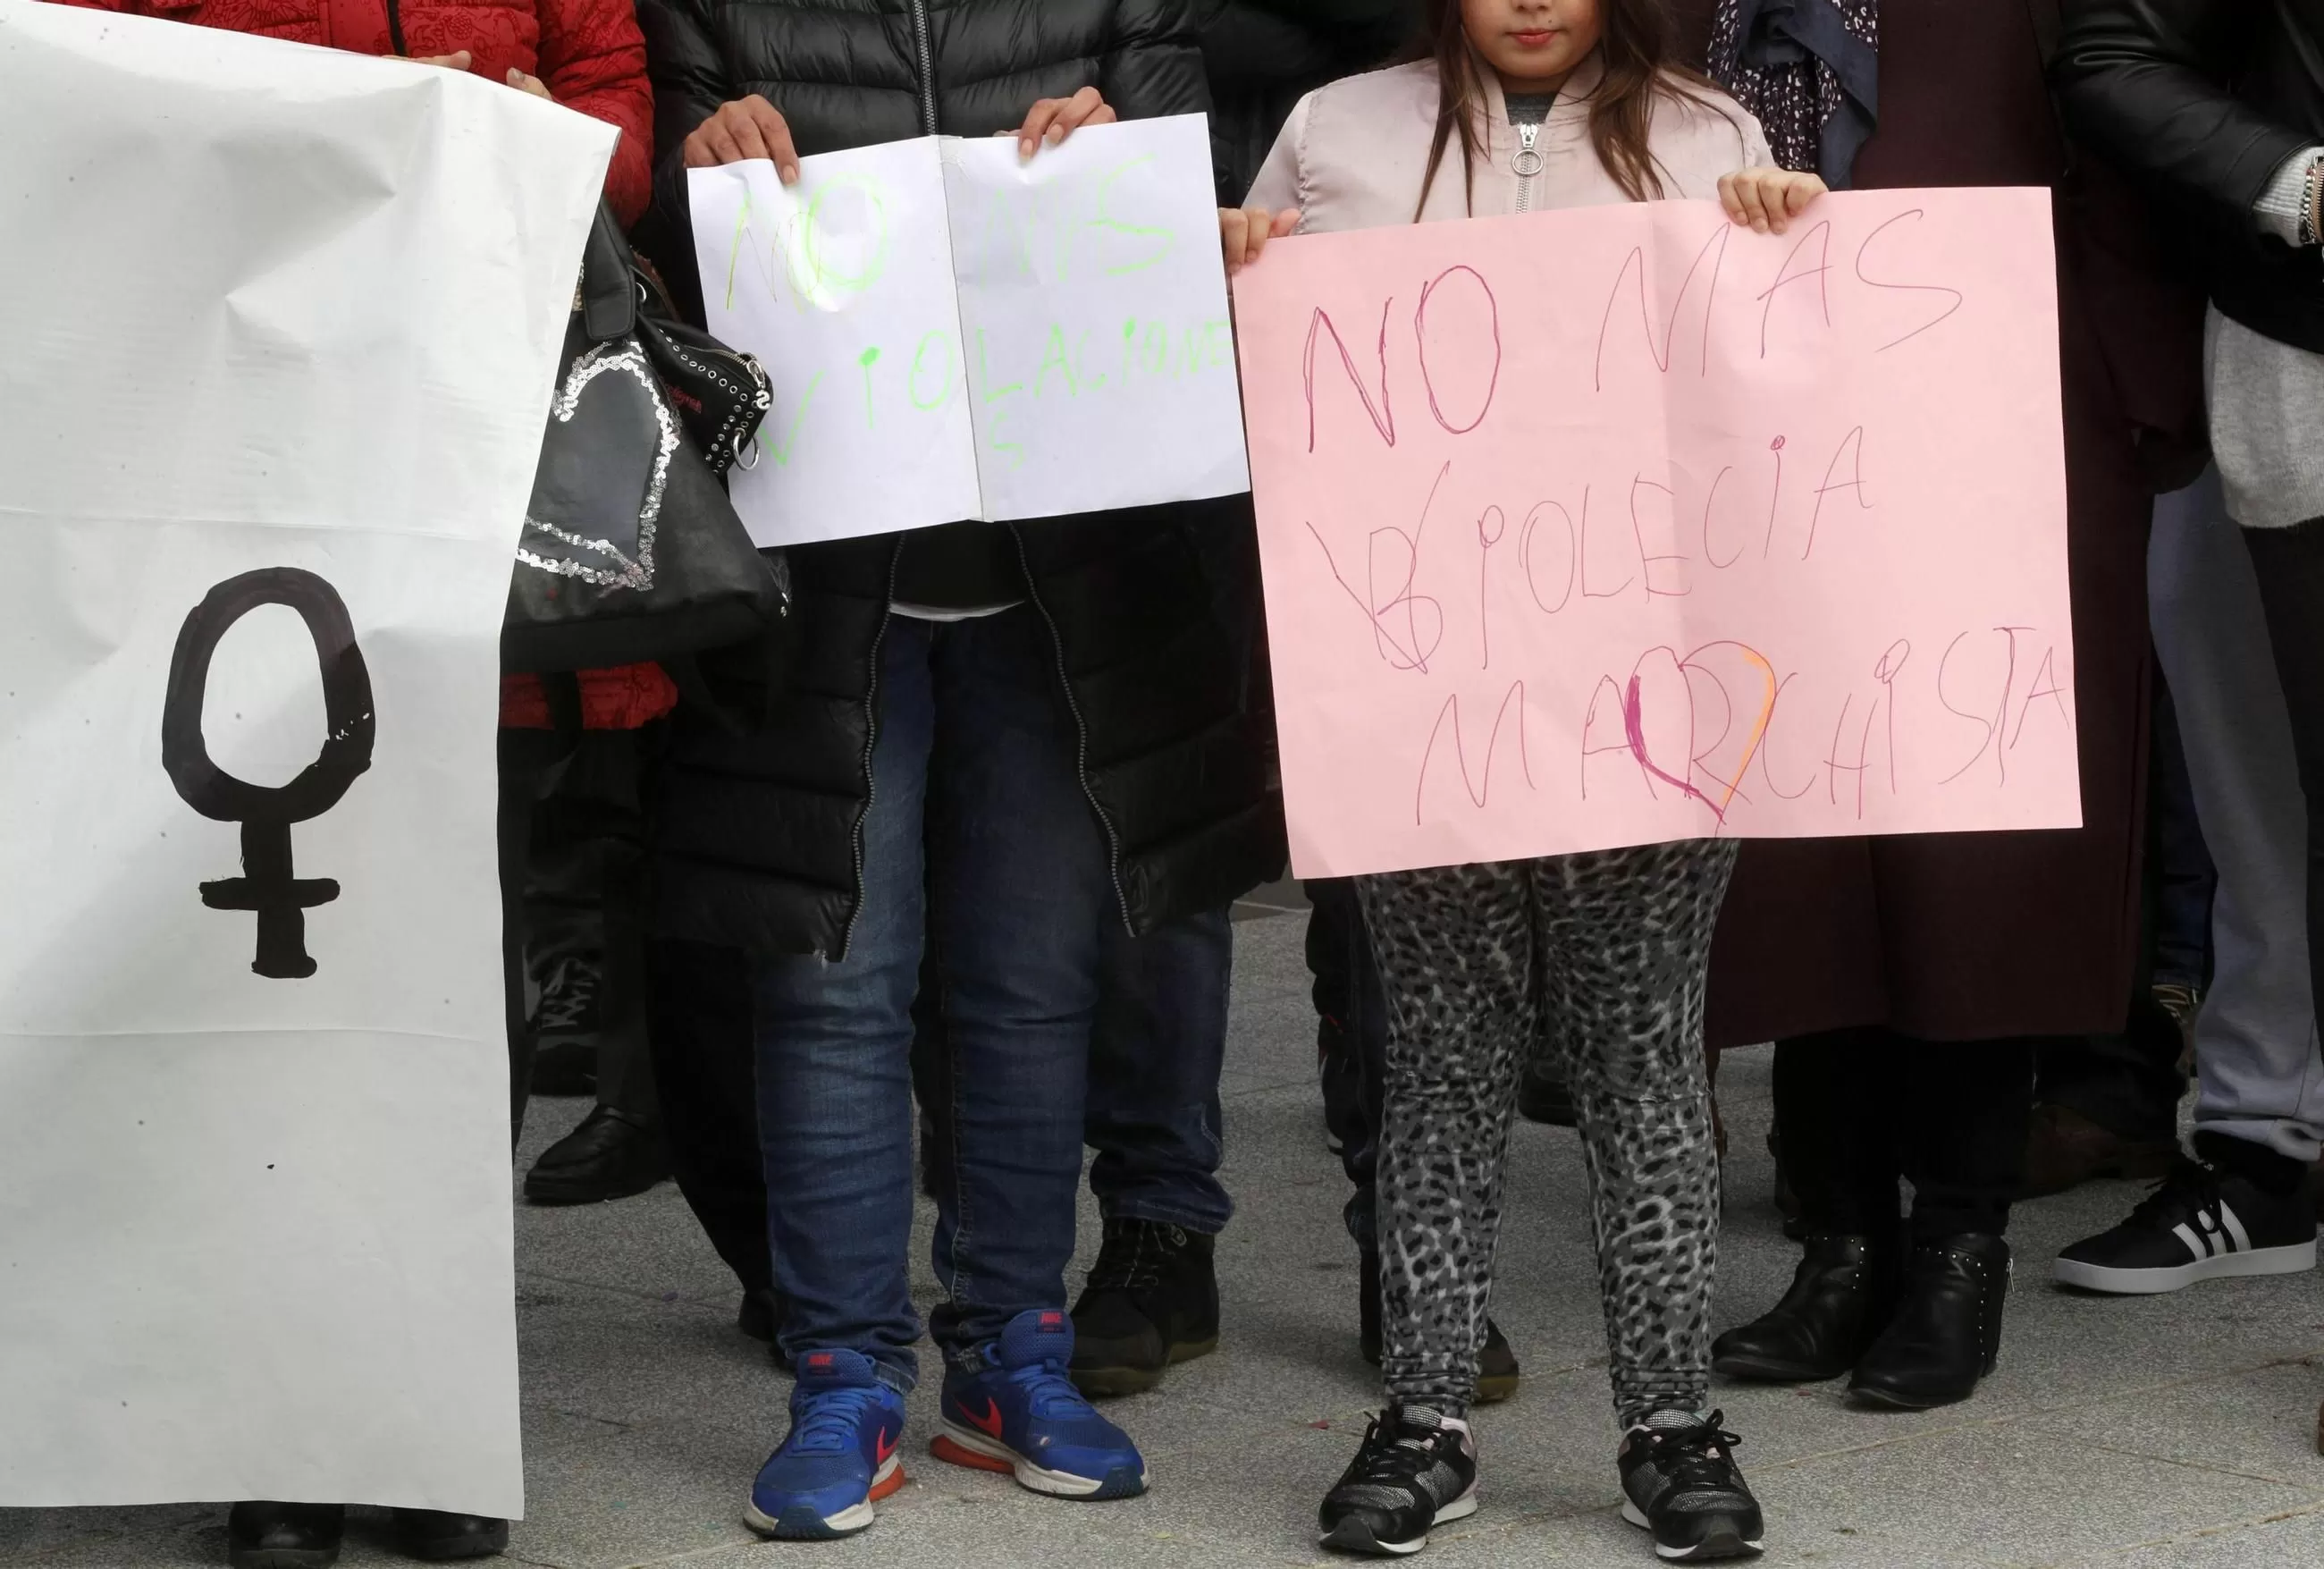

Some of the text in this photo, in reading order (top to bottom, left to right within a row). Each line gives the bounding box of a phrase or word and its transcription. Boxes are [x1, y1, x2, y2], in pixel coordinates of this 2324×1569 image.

[725, 171, 888, 315] NO
[1303, 209, 1963, 452] NO MAS
